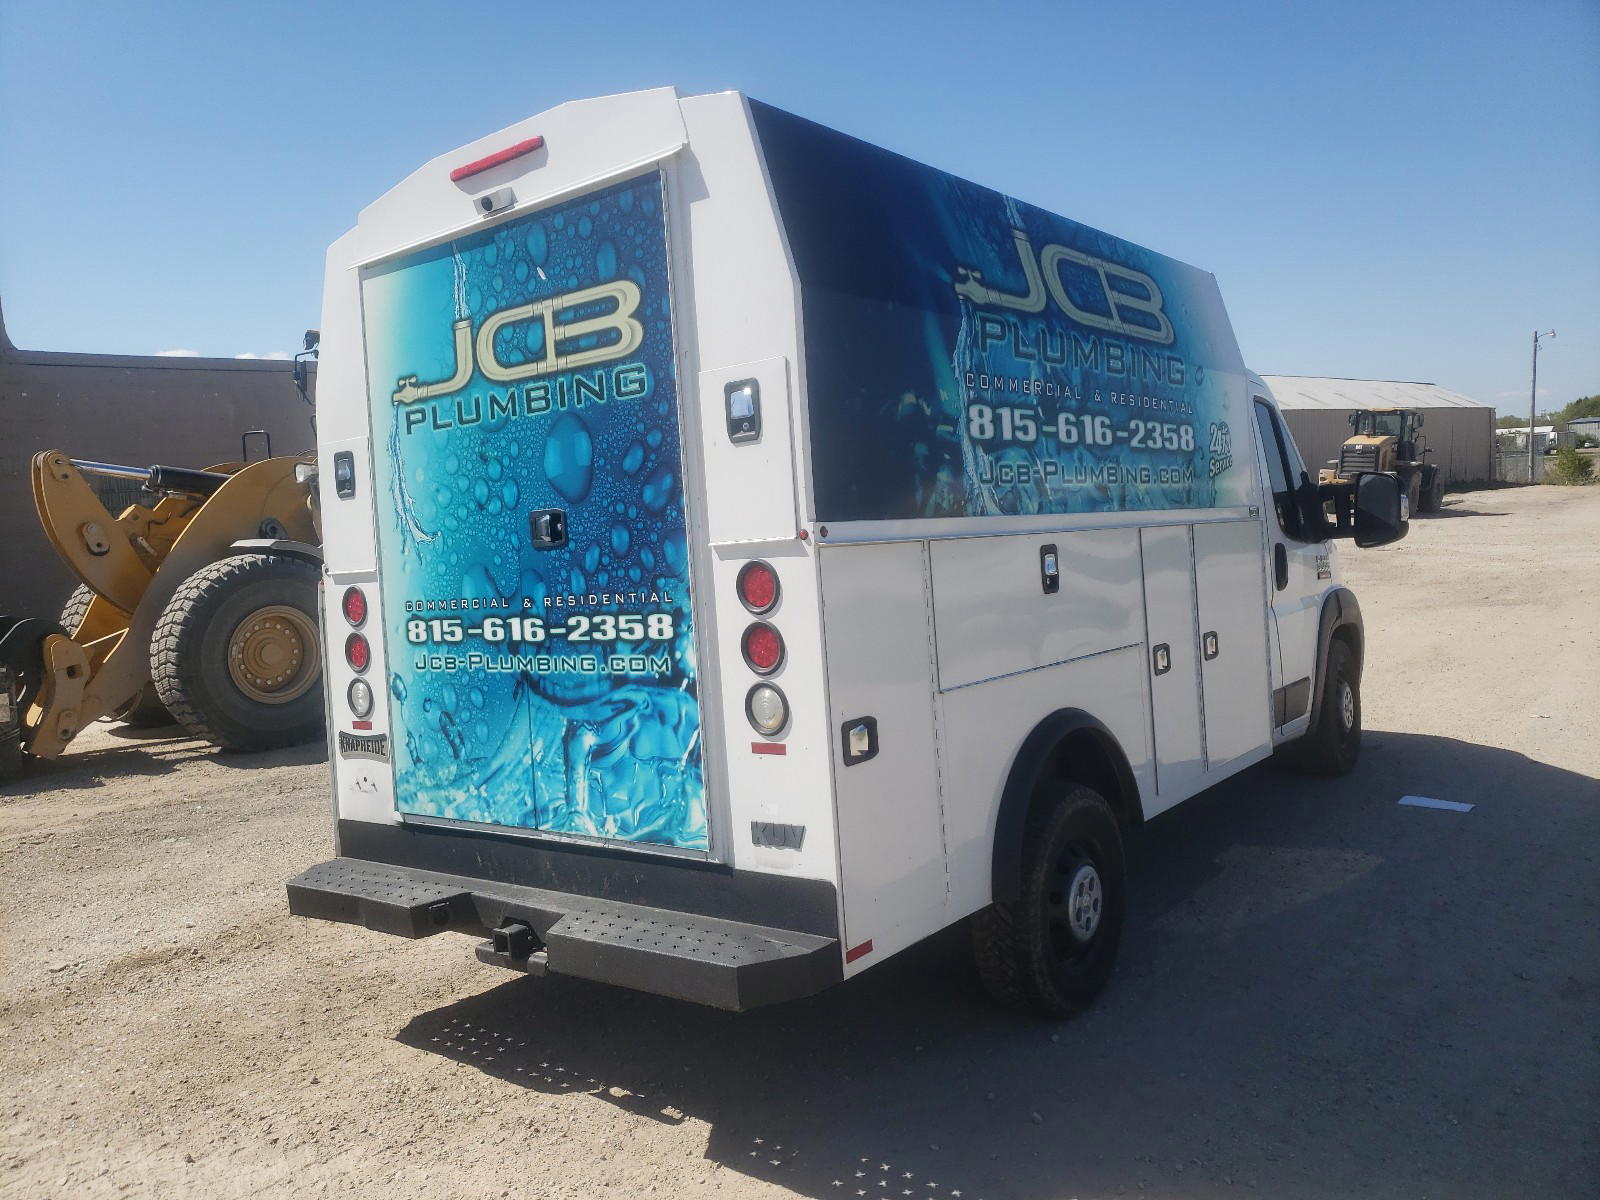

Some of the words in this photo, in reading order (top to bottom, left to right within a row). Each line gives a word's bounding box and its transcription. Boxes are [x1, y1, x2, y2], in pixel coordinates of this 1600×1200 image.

[955, 229, 1174, 344] JCB
[392, 280, 645, 404] JCB
[976, 312, 1186, 386] PLUMBING
[405, 363, 648, 435] PLUMBING
[966, 373, 1081, 399] COMMERCIAL
[1094, 389, 1101, 402] &
[1111, 391, 1194, 414] RESIDENTIAL
[968, 403, 1195, 452] 815-616-2358
[405, 597, 509, 611] COMMERCIAL
[523, 598, 532, 608] &
[544, 591, 673, 607] RESIDENTIAL
[407, 613, 674, 643] 815-616-2358
[339, 736, 386, 756] KNAPHEIDE
